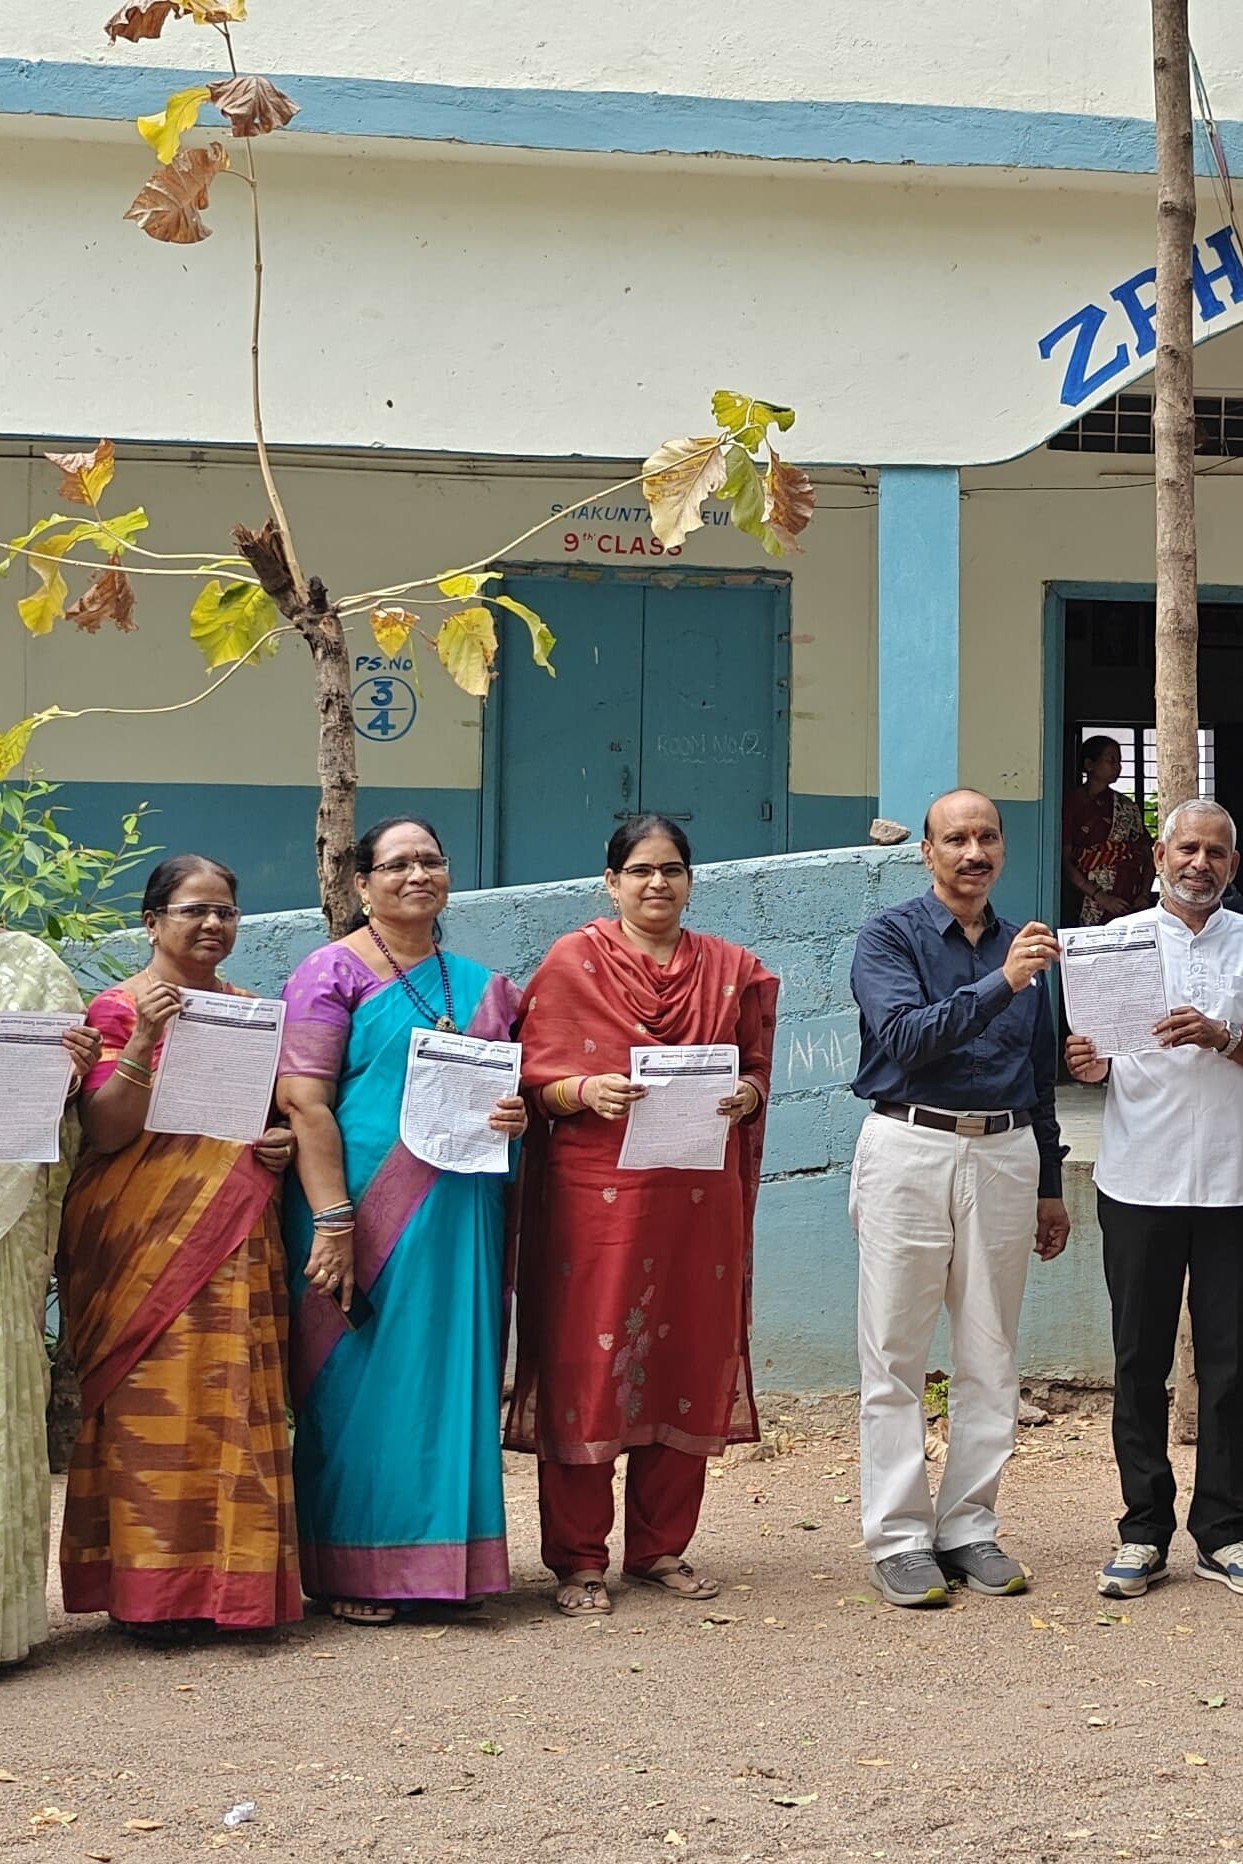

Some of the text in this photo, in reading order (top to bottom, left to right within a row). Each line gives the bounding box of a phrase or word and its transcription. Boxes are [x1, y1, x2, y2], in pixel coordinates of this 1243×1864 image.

[700, 511, 729, 526] EVI
[370, 680, 394, 707] 3
[367, 710, 397, 736] 4
